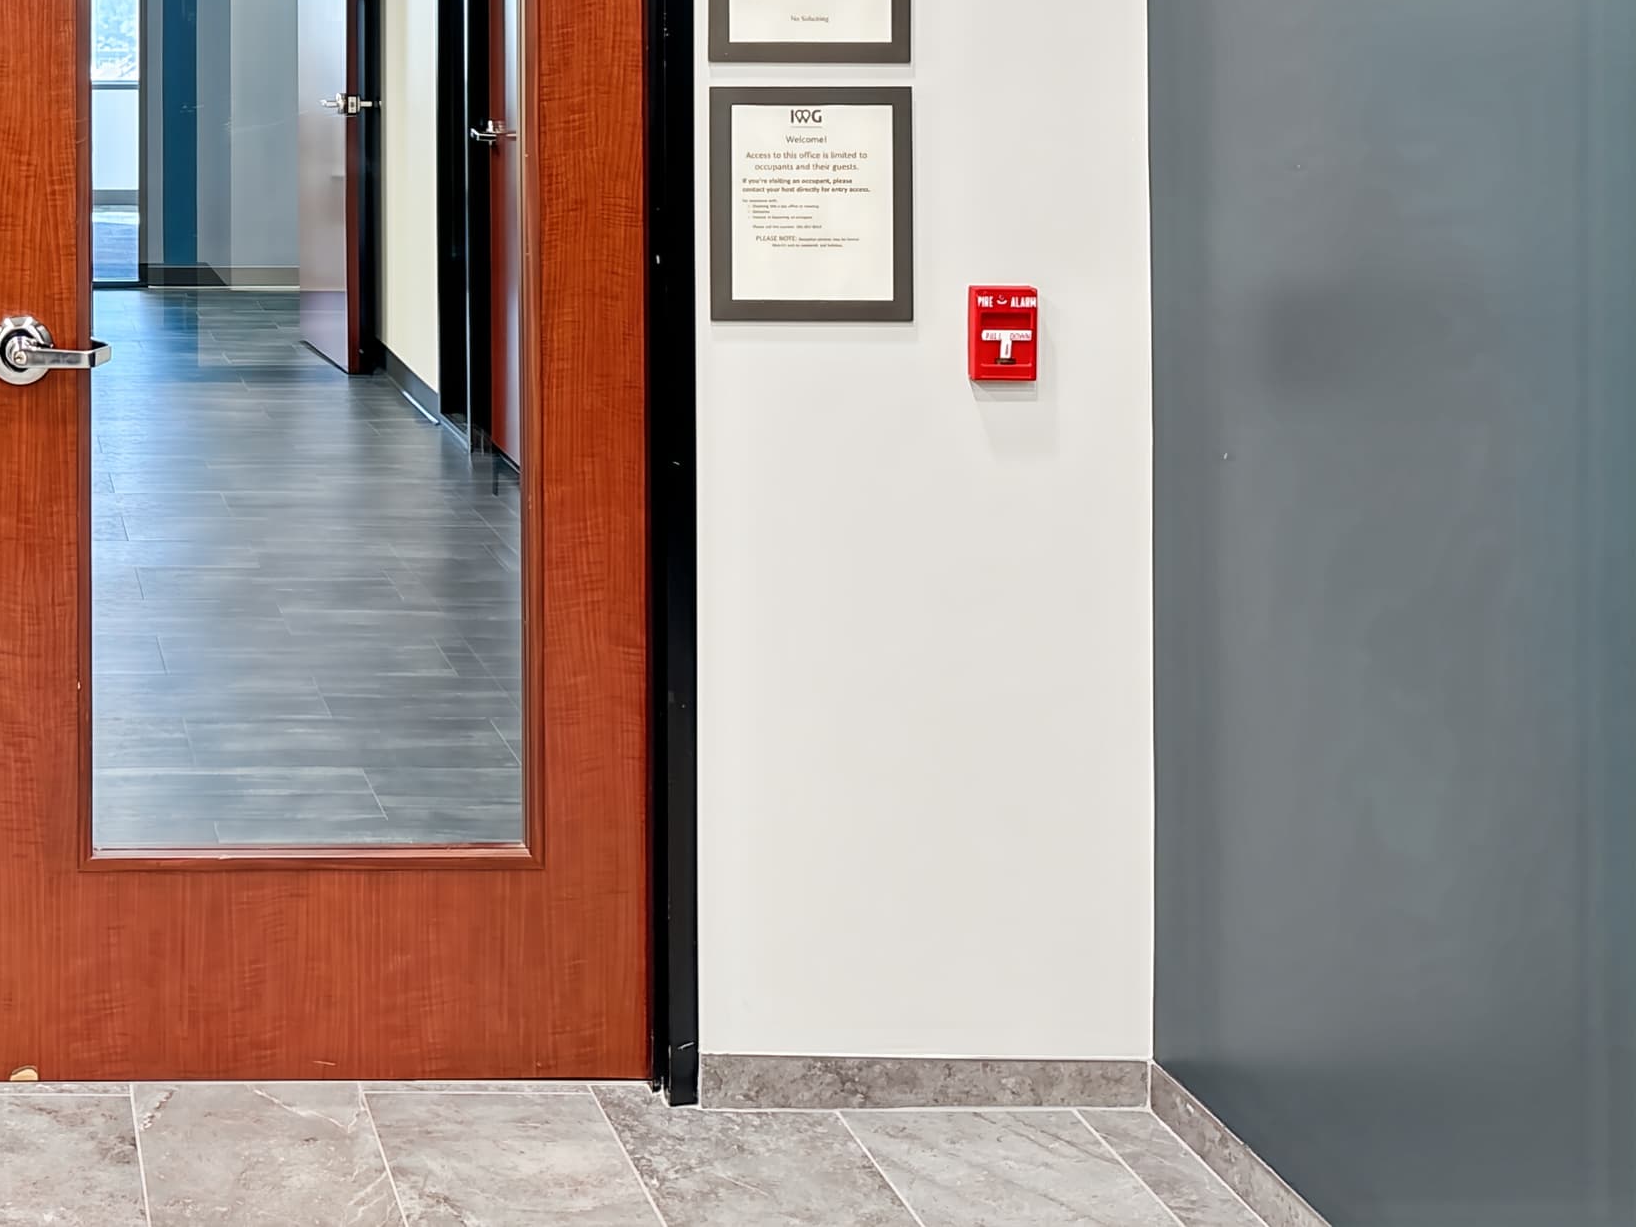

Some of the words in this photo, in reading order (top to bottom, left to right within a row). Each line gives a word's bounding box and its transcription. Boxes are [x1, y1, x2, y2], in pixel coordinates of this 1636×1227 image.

[791, 109, 822, 124] IWG
[785, 135, 827, 144] Welcome!
[746, 151, 771, 159] Access
[773, 151, 781, 159] to
[783, 151, 797, 159] this
[799, 151, 821, 159] office
[822, 151, 829, 159] is
[830, 151, 857, 159] limited
[859, 151, 868, 159] to
[832, 164, 859, 172] guests.
[768, 177, 791, 185] visiting
[832, 177, 853, 185] please
[977, 296, 994, 307] FIRE
[1010, 296, 1037, 308] ALARM
